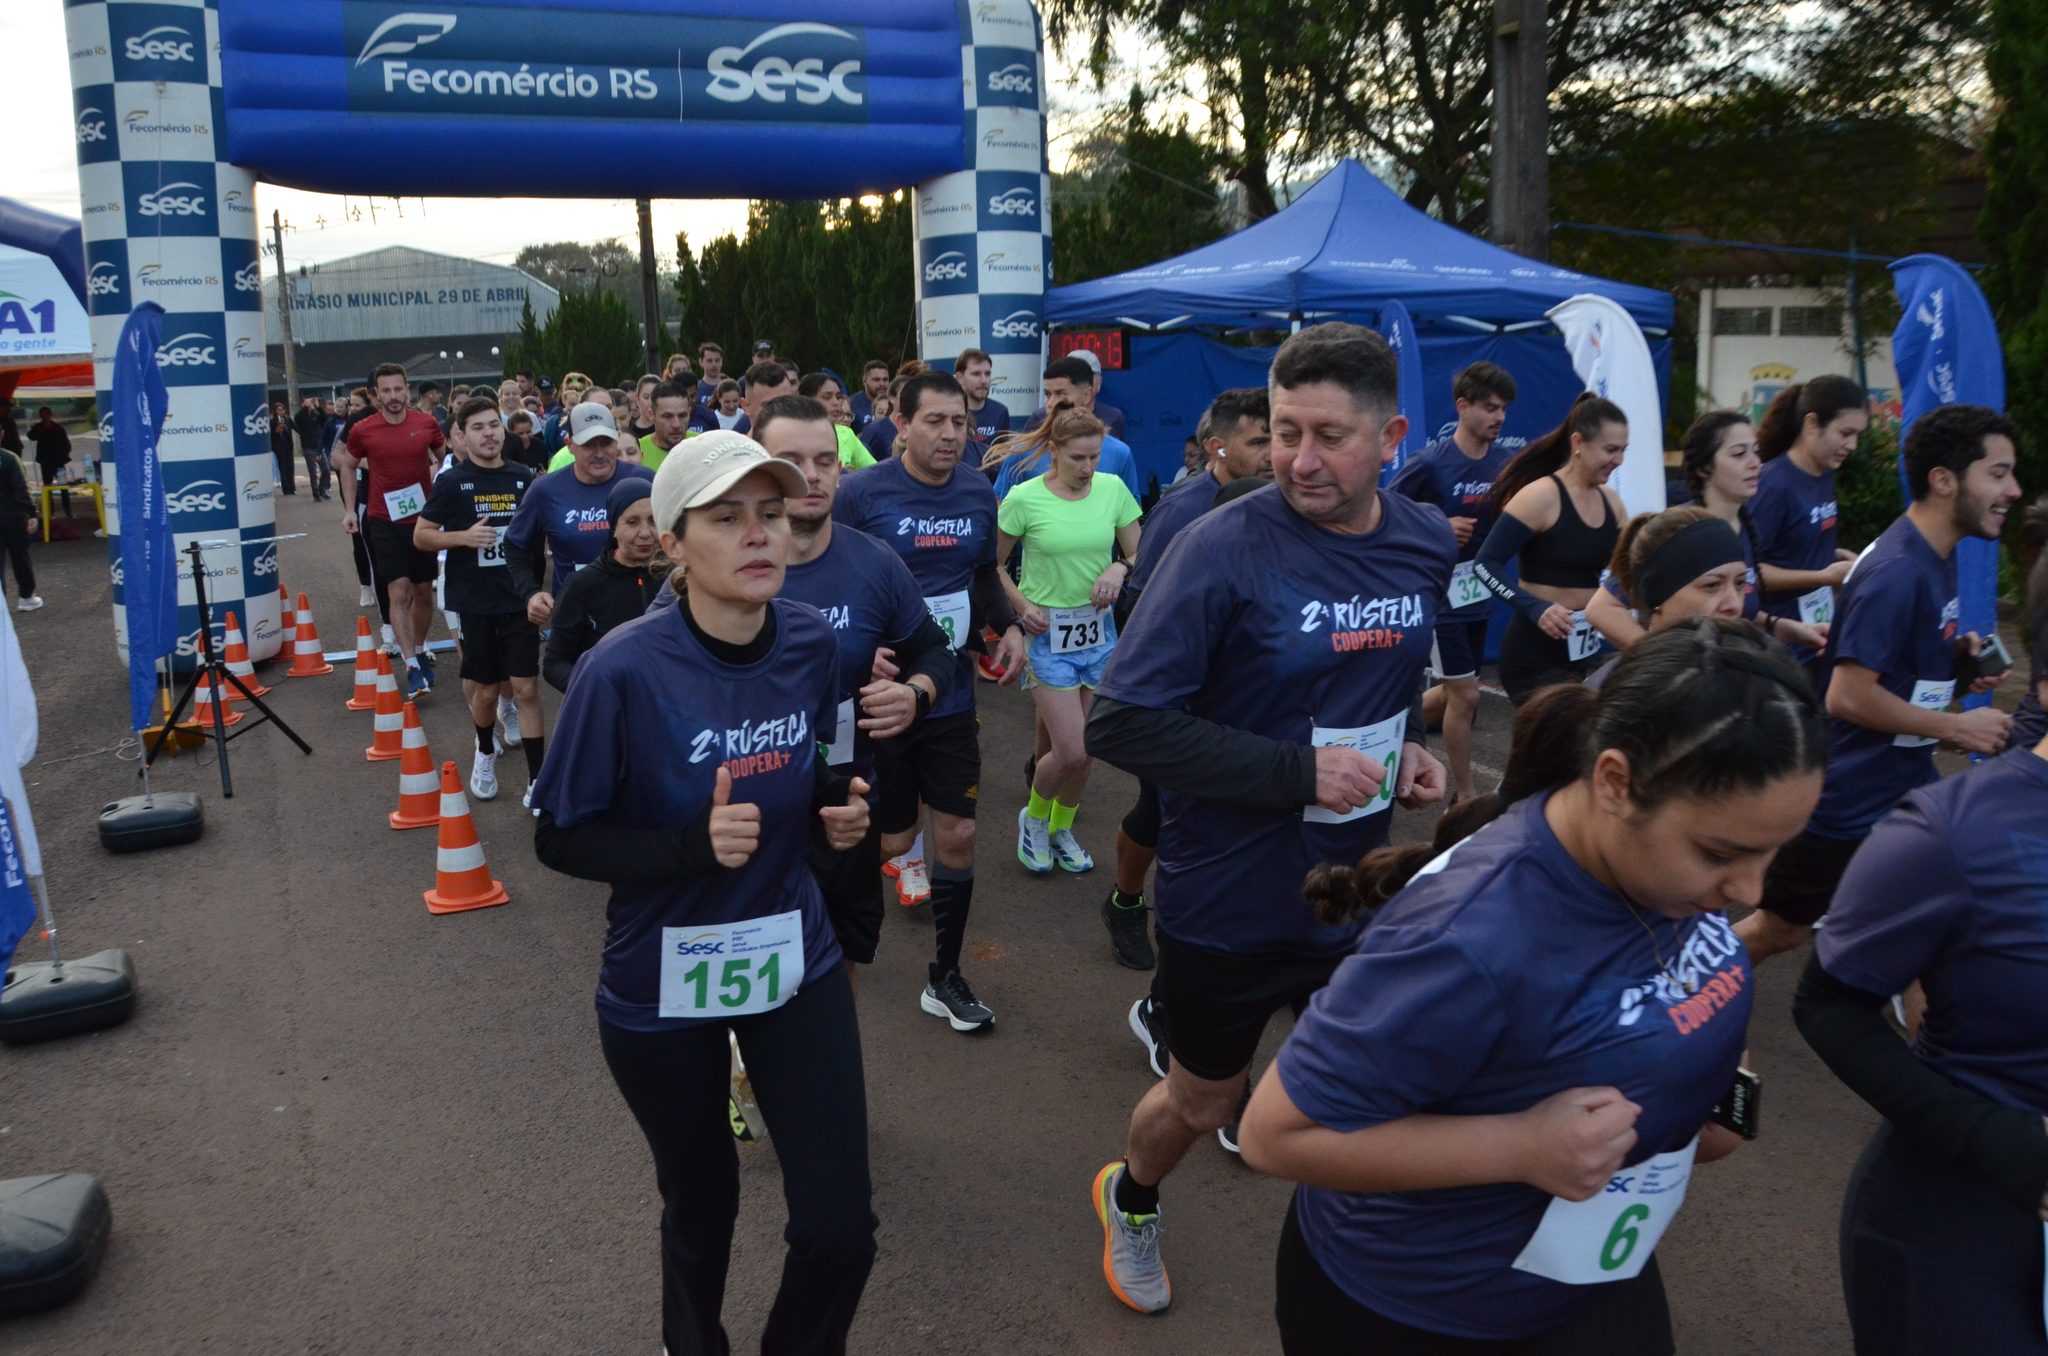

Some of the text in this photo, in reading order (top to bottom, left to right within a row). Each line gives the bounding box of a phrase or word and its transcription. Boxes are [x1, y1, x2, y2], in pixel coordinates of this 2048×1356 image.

[125, 37, 194, 62] Sesc
[384, 62, 658, 99] Fecomércio RS
[706, 47, 863, 105] Sesc
[988, 71, 1032, 94] Sesc
[130, 121, 208, 134] Fecomércio RS
[108, 202, 120, 212] RS
[138, 193, 206, 216] Sesc
[989, 196, 1035, 216] Sesc
[142, 276, 218, 286] Fecomércio RS
[925, 261, 967, 281] Sesc
[290, 287, 525, 310] INÁSIO MUNICIPAL 29 DE ABRIL
[992, 320, 1038, 338] Sesc
[14, 338, 56, 351] gente
[155, 345, 216, 366] Sesc
[161, 423, 228, 435] ecomércio RS
[143, 447, 153, 520] Sindicatos
[165, 492, 226, 514] Sesc
[397, 496, 418, 515] 54
[474, 494, 516, 503] FINISHER
[578, 521, 610, 531] COOPERA
[918, 515, 972, 536] RÚSTICA
[915, 535, 959, 548] COOPERA+
[226, 567, 239, 576] RS
[1457, 576, 1482, 601] 32
[1488, 576, 1500, 589] TO
[1496, 583, 1516, 600] PLAY
[1333, 594, 1424, 631] RÚSTICA
[1058, 620, 1099, 649] 733
[1331, 629, 1405, 653] COOPERA+
[726, 710, 807, 757] RÚSTICA
[677, 941, 725, 956] Sesc
[684, 952, 780, 1009] 151
[1668, 963, 1746, 1035] COOPERA+
[1599, 1203, 1651, 1271] 6
